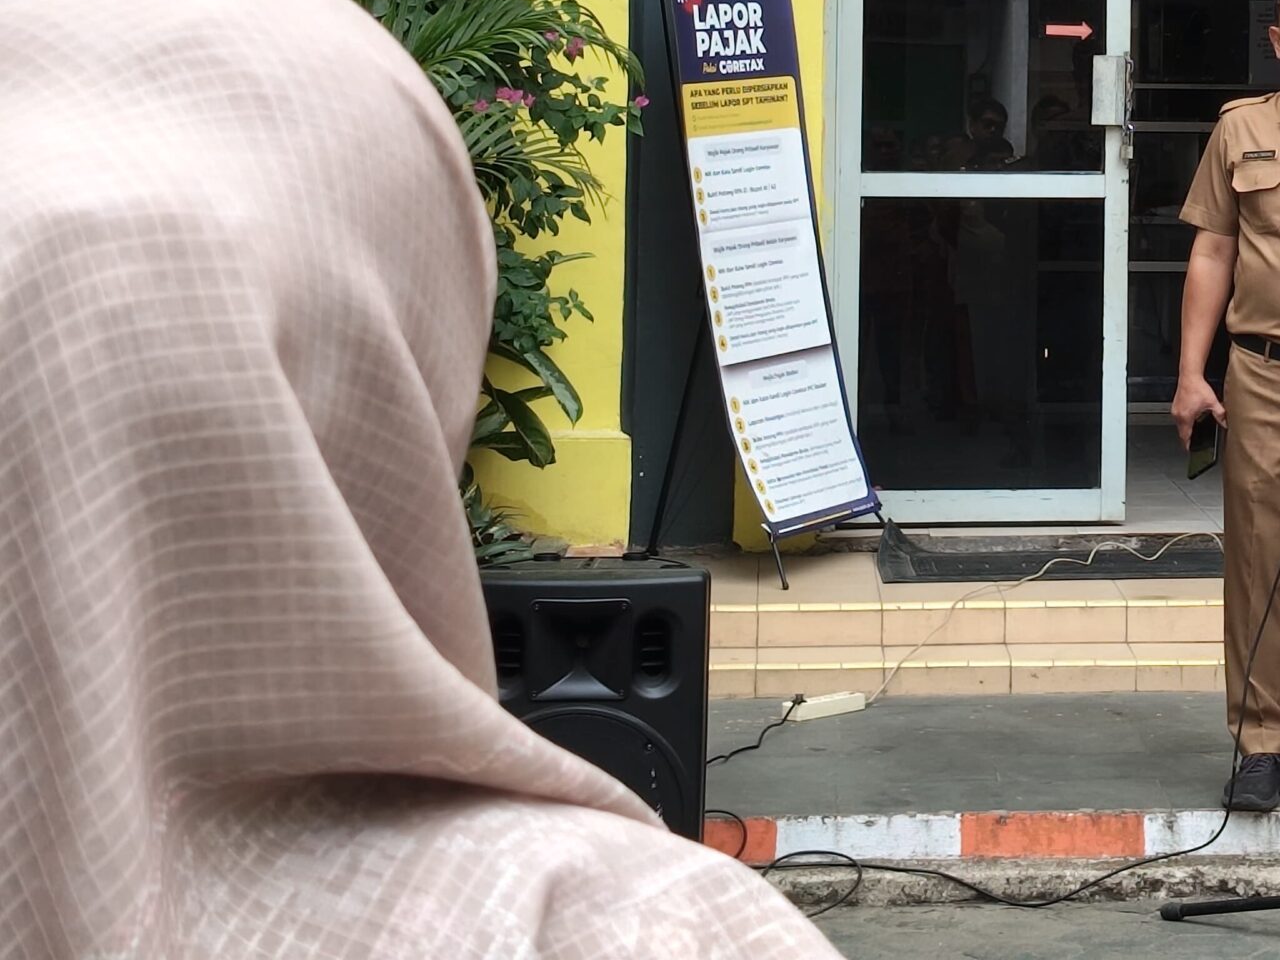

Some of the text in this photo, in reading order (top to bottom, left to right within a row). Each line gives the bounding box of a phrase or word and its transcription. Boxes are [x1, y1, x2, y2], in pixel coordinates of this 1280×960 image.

[692, 2, 763, 30] LAPOR
[696, 28, 767, 57] PAJAK
[719, 58, 765, 75] CORETAX
[690, 88, 703, 98] APA
[704, 87, 720, 96] YANG
[720, 98, 741, 108] LAPOR
